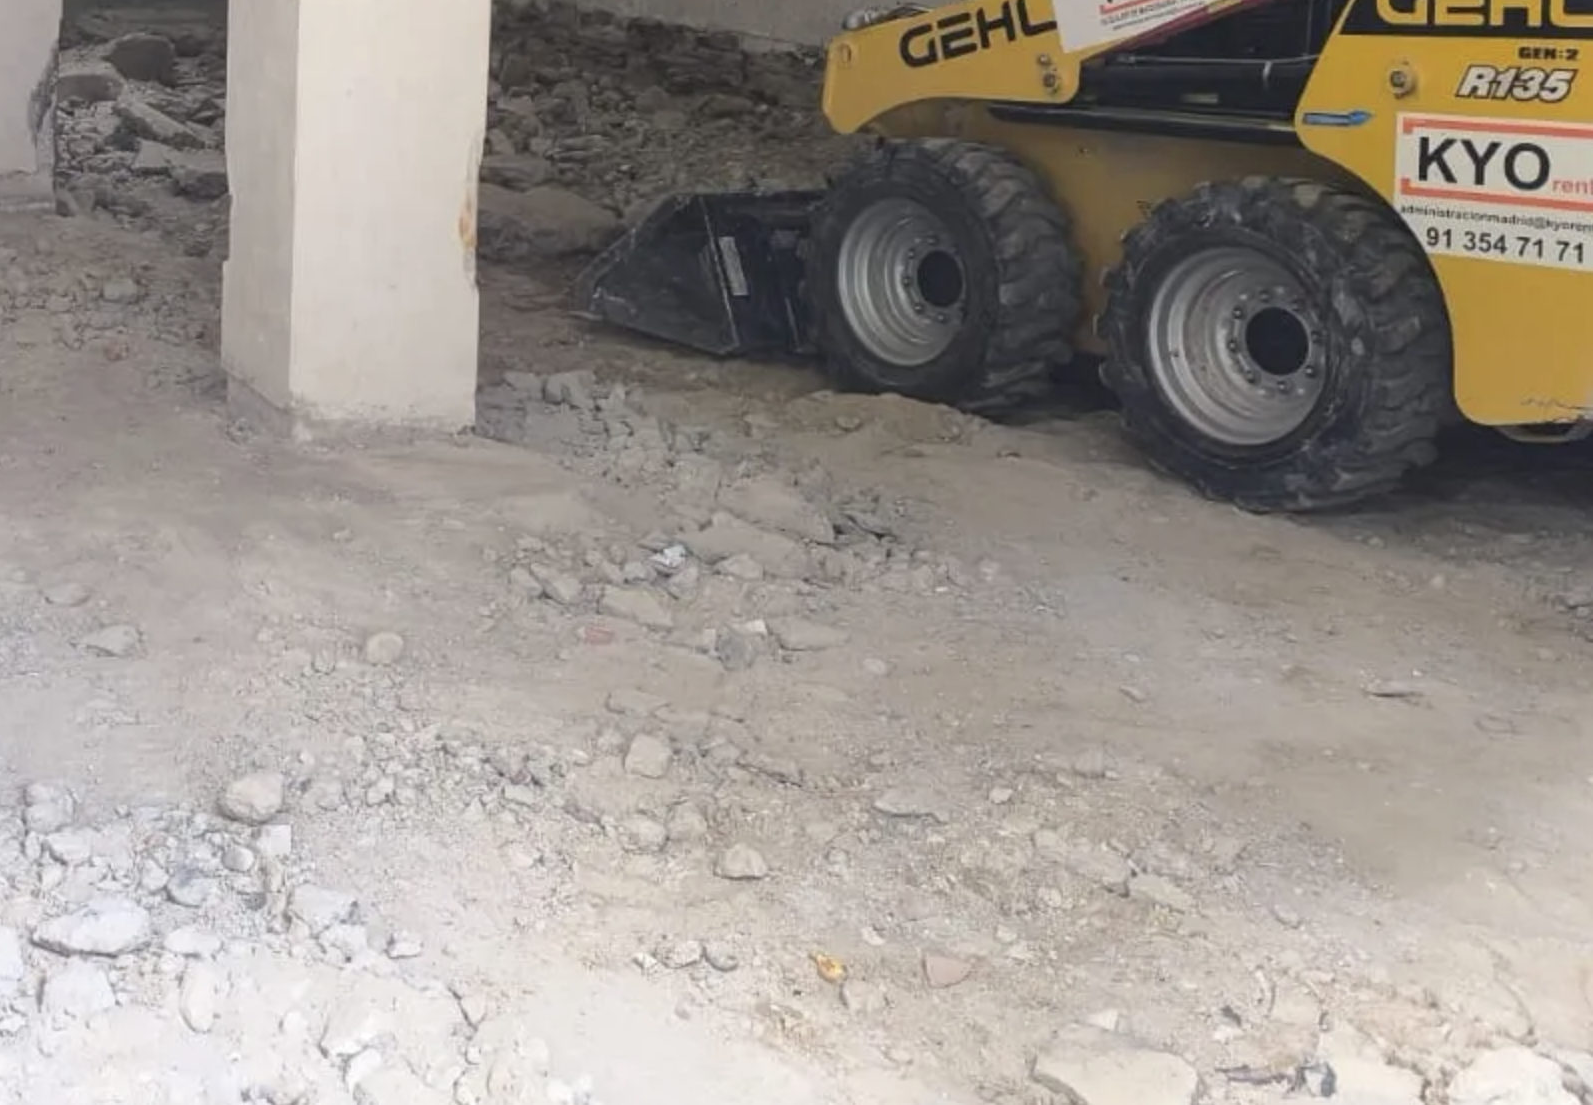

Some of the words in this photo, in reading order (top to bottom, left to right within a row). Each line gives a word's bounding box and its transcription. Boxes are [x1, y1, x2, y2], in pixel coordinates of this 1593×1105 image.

[1455, 63, 1579, 103] R135
[1418, 136, 1551, 191] KYO
[1425, 226, 1453, 249] 91
[1462, 230, 1507, 255] 354
[1516, 236, 1544, 259] 71
[1555, 240, 1585, 264] 71
